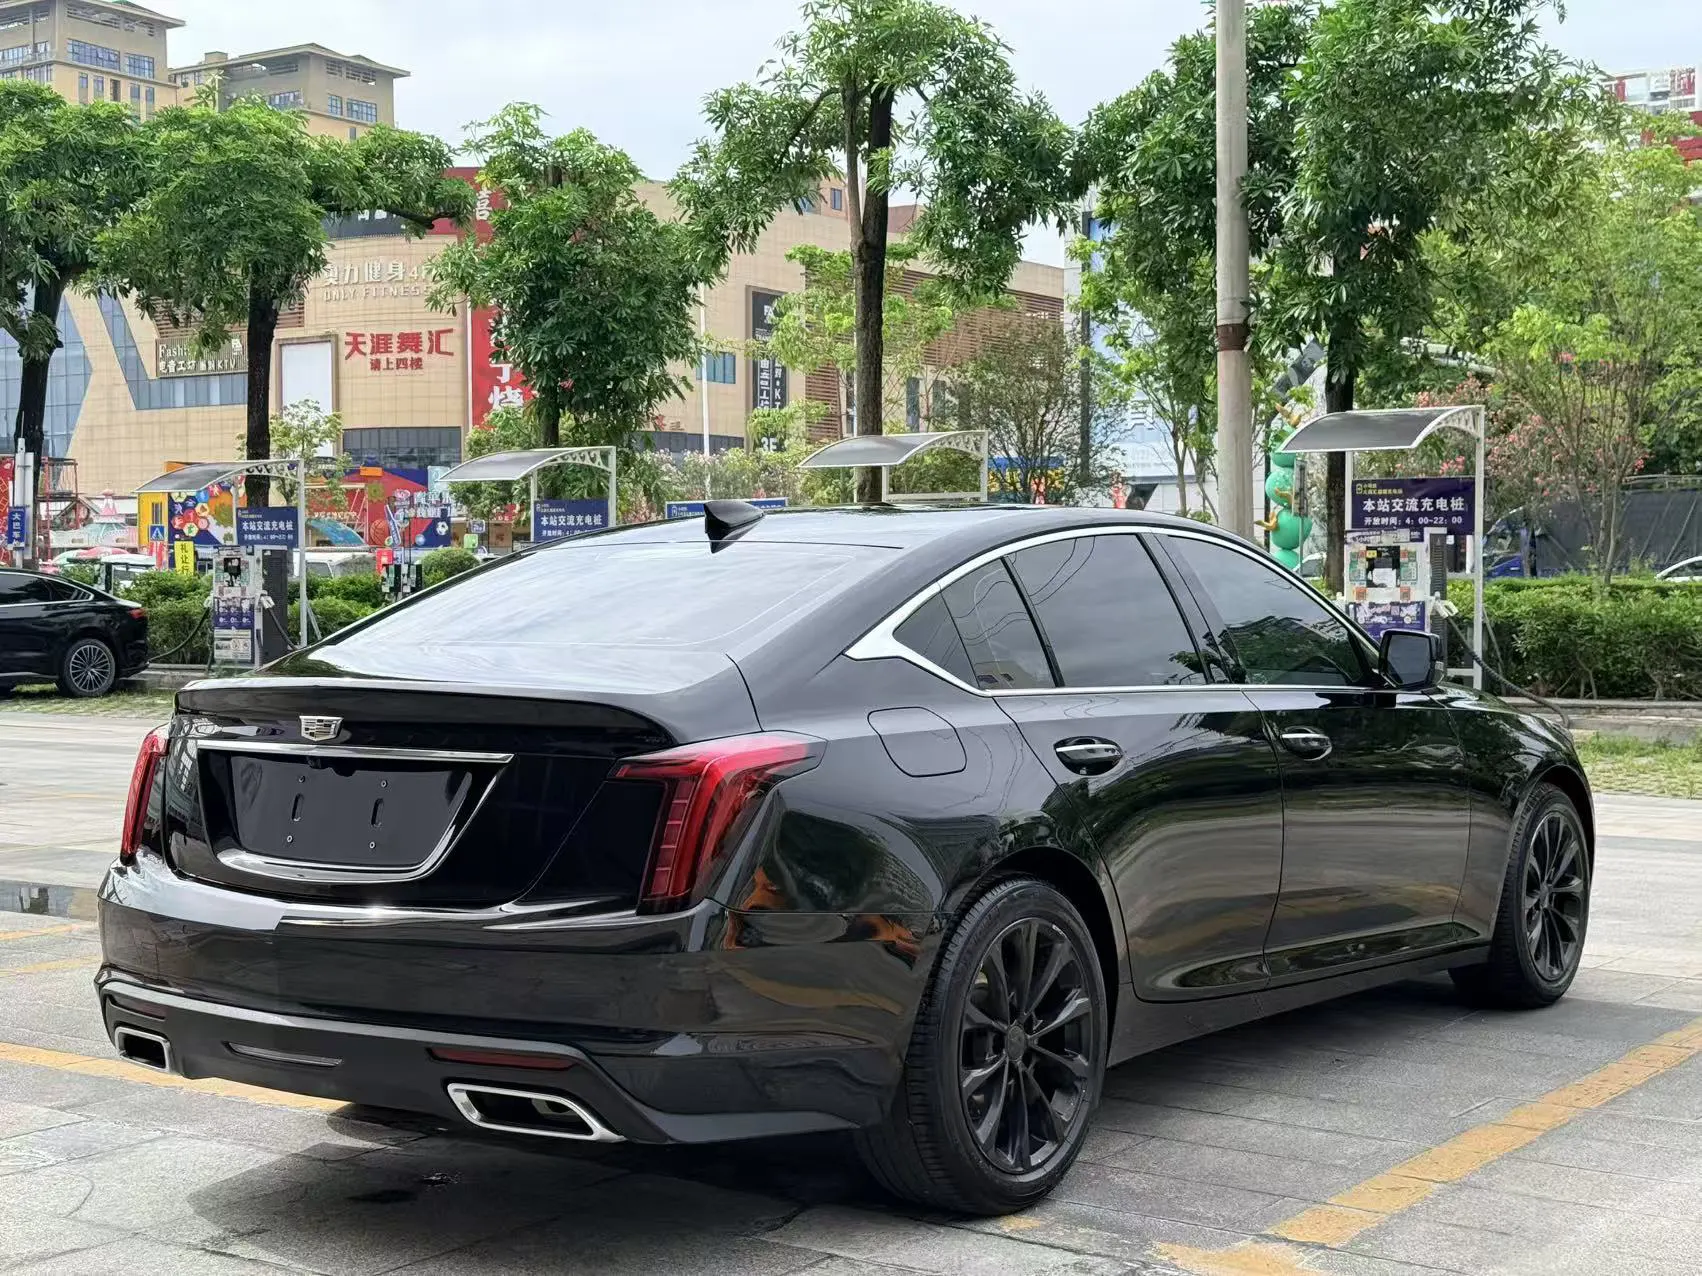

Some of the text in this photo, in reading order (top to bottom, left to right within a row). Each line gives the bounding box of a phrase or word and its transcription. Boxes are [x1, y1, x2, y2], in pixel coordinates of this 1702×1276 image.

[323, 287, 357, 302] ONLY
[344, 327, 455, 361] 天涯舞汇
[369, 356, 424, 372] 请上四楼
[1362, 496, 1465, 513] 本站交流充电桩
[241, 519, 294, 531] 本站交流充电桩
[541, 513, 603, 527] 本站交流充电桩
